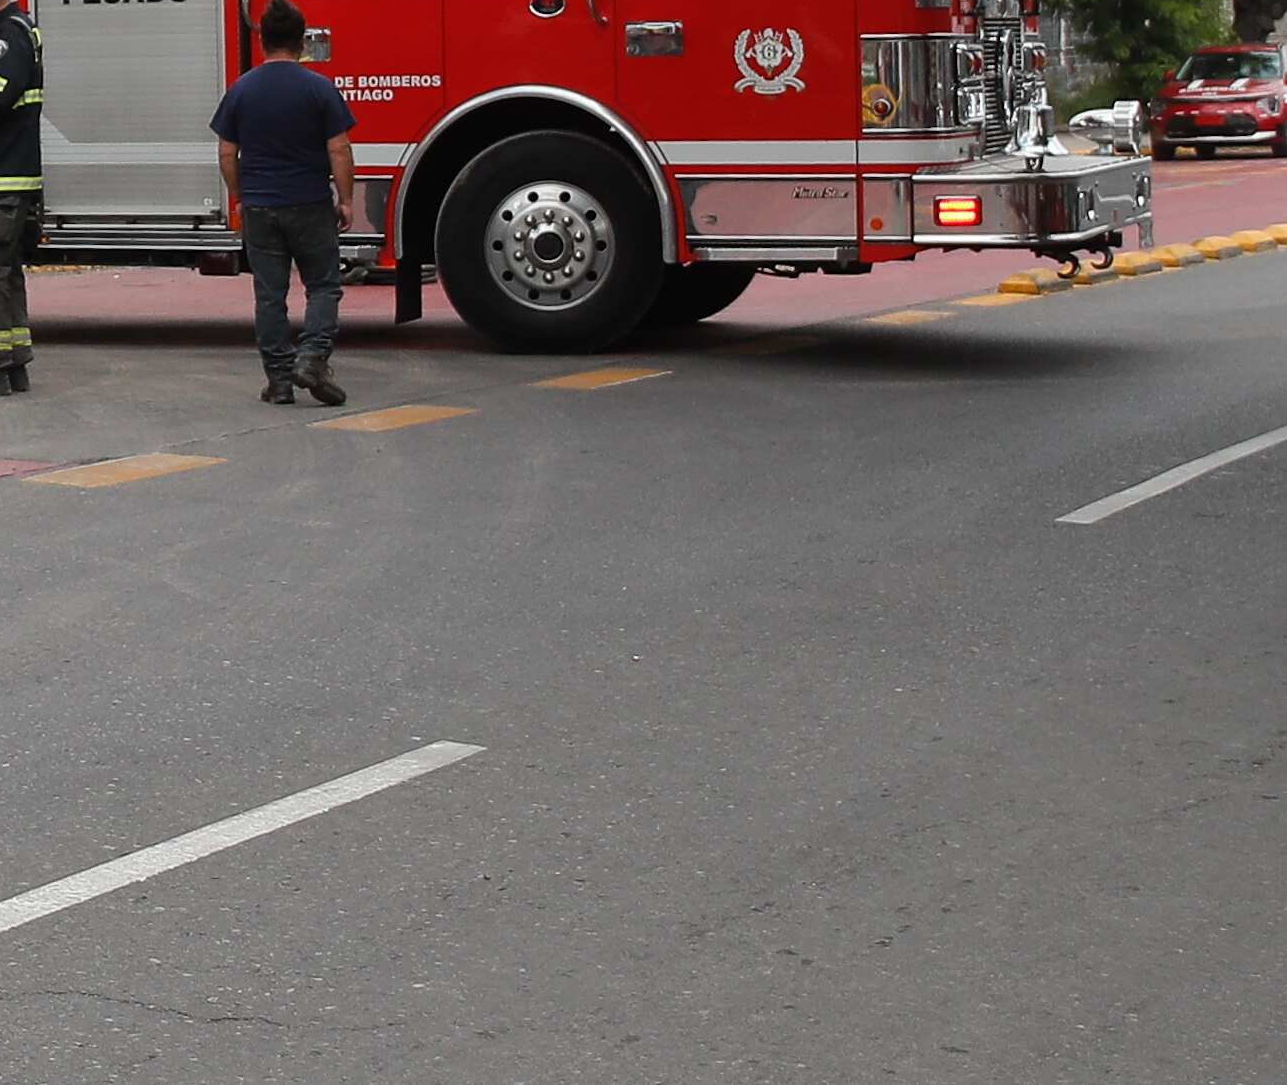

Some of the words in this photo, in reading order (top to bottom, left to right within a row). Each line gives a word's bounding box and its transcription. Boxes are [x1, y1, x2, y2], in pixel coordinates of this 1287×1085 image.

[764, 45, 774, 59] 6
[334, 76, 355, 88] DE
[358, 75, 442, 87] BOMBEROS
[338, 89, 394, 102] NTIAGO
